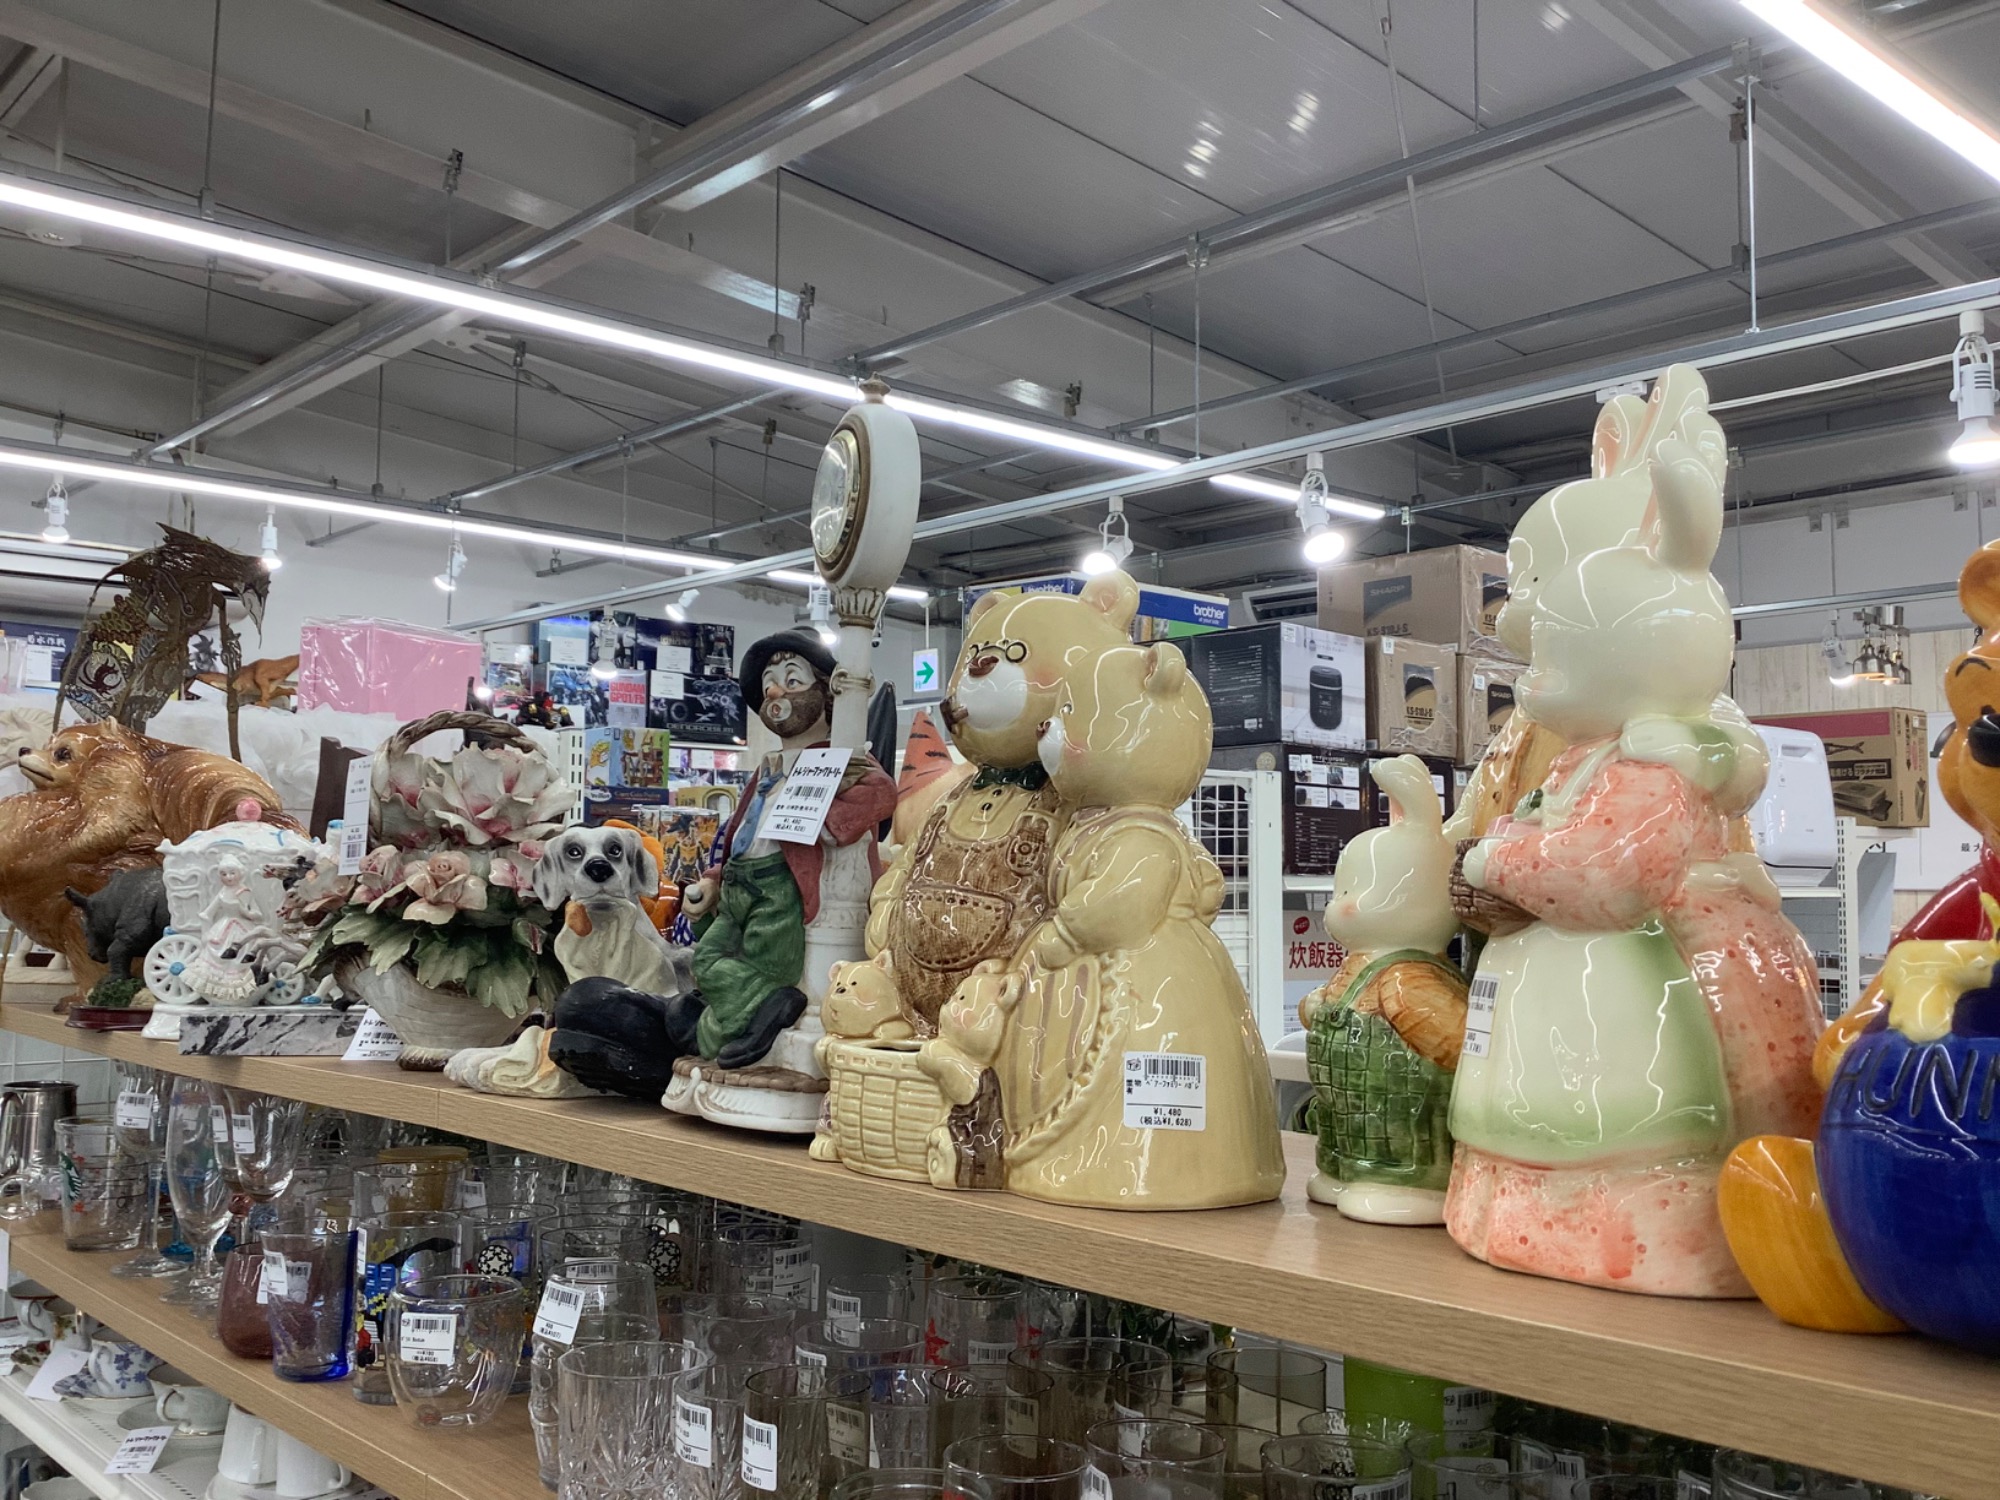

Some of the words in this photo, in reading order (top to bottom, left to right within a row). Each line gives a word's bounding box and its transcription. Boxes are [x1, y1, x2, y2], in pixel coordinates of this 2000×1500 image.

[1370, 585, 1406, 597] SHARP
[1193, 603, 1225, 619] brother
[610, 681, 646, 695] GUNDAM
[666, 722, 734, 734] DENDROBIUM
[1289, 940, 1349, 969] 炊飯器
[1153, 1107, 1183, 1117] ¥1,480
[1139, 1115, 1193, 1127] (税込¥1,628)
